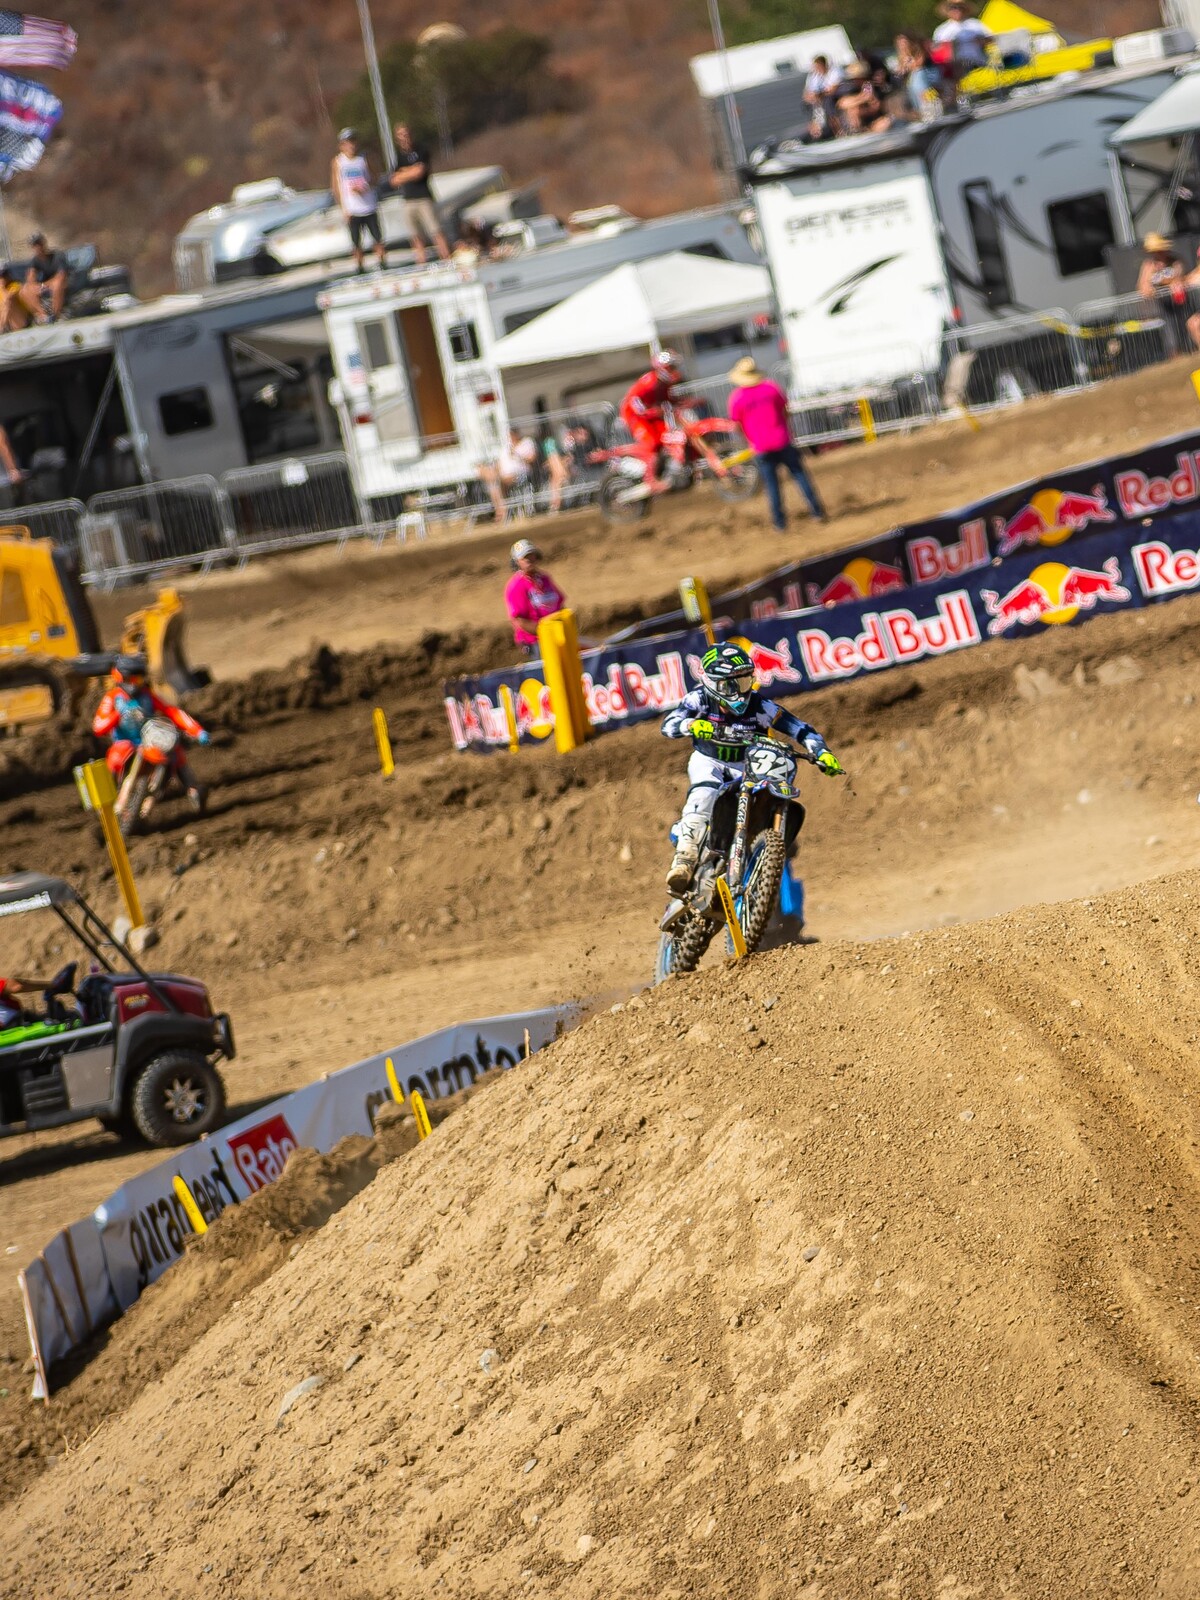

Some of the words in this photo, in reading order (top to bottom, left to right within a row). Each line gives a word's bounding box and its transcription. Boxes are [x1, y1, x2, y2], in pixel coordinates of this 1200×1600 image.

[1113, 452, 1199, 520] Red
[905, 517, 991, 585] Bull
[797, 612, 894, 682] Red
[880, 589, 982, 662] Bull
[622, 651, 688, 712] Bull
[751, 749, 795, 782] 32
